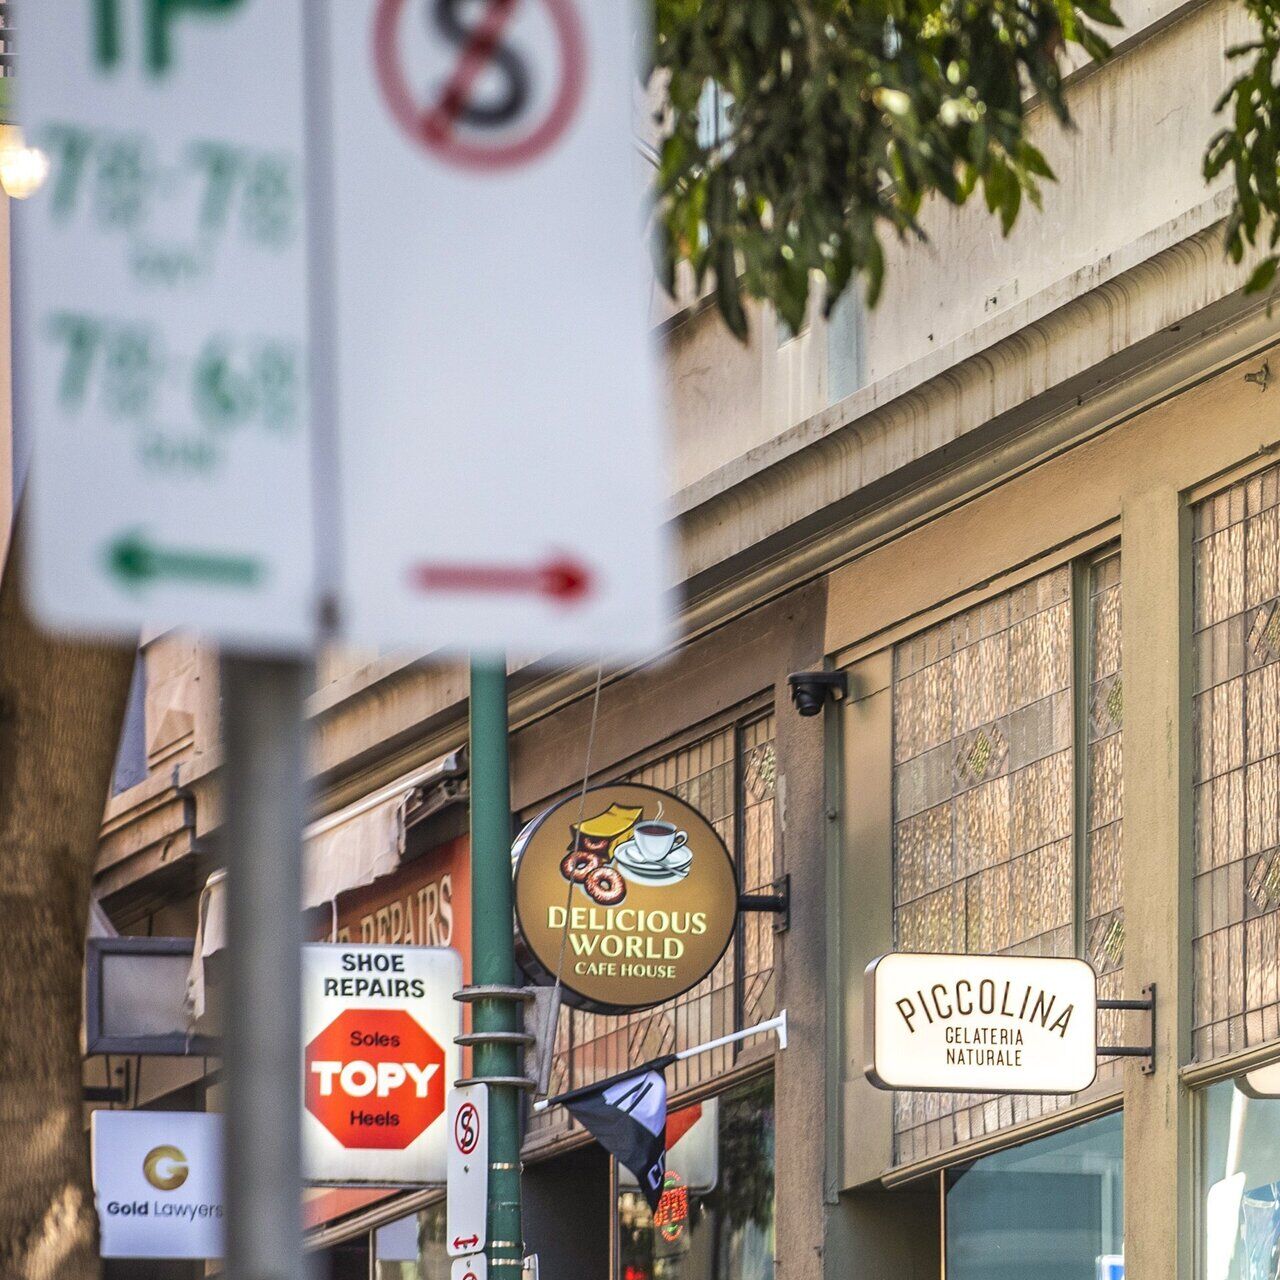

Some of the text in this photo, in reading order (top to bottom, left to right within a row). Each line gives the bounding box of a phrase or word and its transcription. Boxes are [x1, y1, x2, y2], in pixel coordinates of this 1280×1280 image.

[548, 906, 707, 935] DELICIOUS
[568, 933, 685, 960] WORLD
[341, 953, 405, 973] SHOE
[574, 961, 676, 979] CAFE HOUSE
[324, 977, 425, 998] REPAIRS
[895, 979, 1074, 1038] PICCOLINA
[350, 1031, 401, 1047] Soles
[945, 1026, 1024, 1045] GELATERIA
[946, 1048, 1022, 1066] NATURALE
[311, 1060, 441, 1098] TOPY
[350, 1110, 400, 1127] Heels
[107, 1201, 223, 1221] Gold Lawyers
